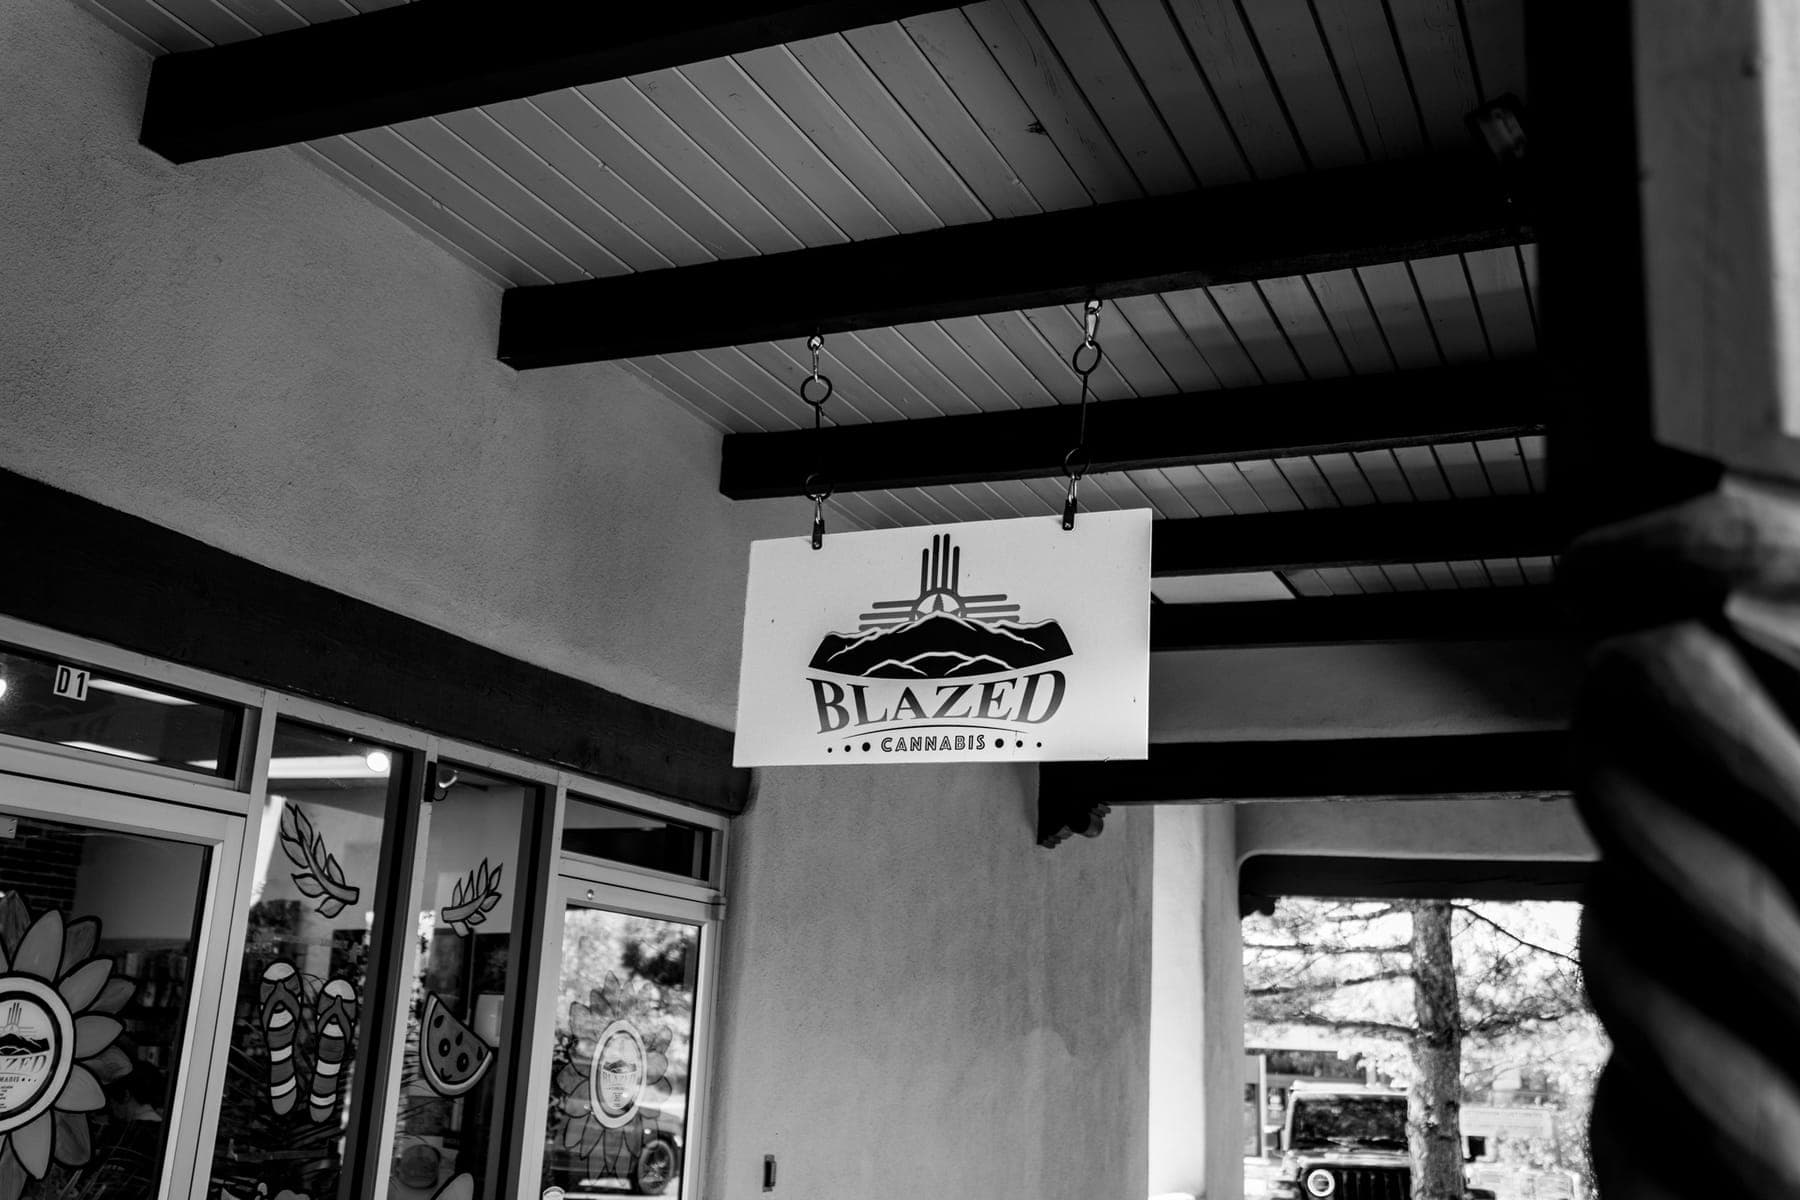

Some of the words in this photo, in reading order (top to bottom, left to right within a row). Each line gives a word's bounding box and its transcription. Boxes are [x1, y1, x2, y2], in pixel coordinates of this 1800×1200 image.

[806, 670, 1067, 734] BLAZED
[880, 734, 987, 753] CANNABIS
[0, 1055, 47, 1073] ZED
